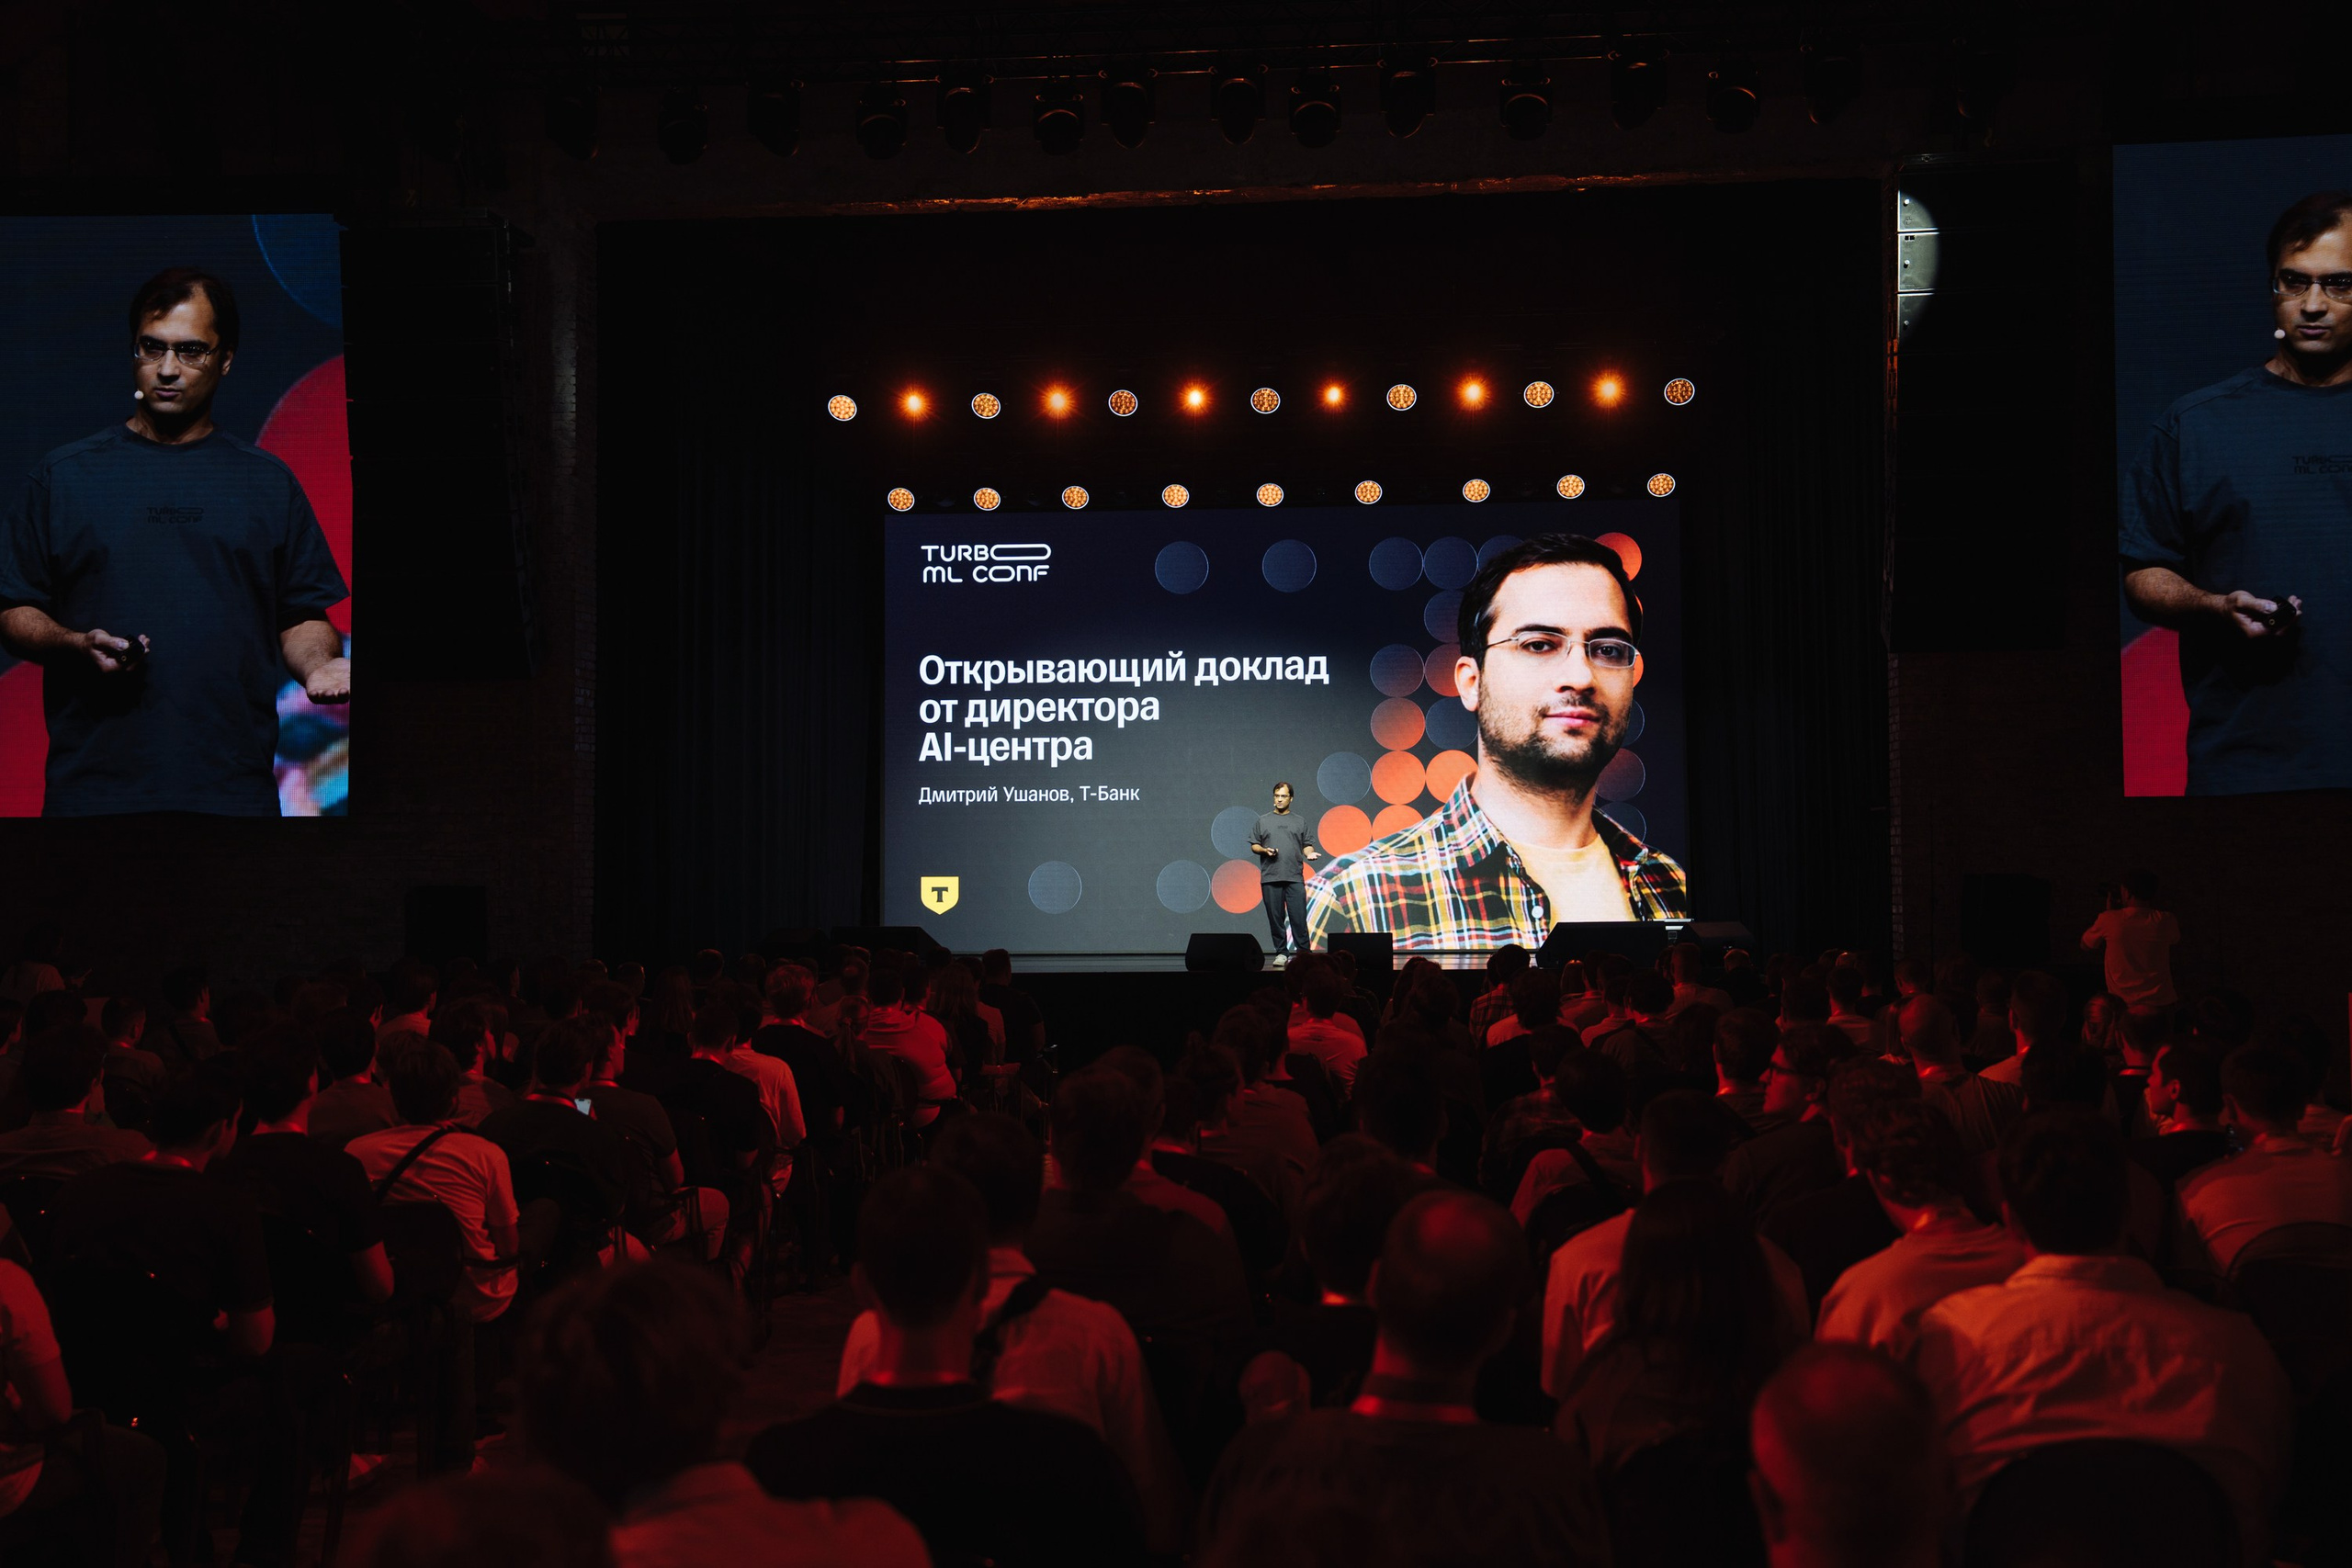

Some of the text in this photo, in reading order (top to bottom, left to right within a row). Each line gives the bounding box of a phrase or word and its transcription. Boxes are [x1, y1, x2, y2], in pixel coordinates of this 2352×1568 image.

[921, 543, 1052, 561] TURBO
[922, 564, 1050, 583] ML CONF
[919, 650, 1329, 692] Открывающий доклад
[919, 695, 1159, 729] от директора
[918, 784, 1140, 806] Дмитрий Ушанов, Т-Банк
